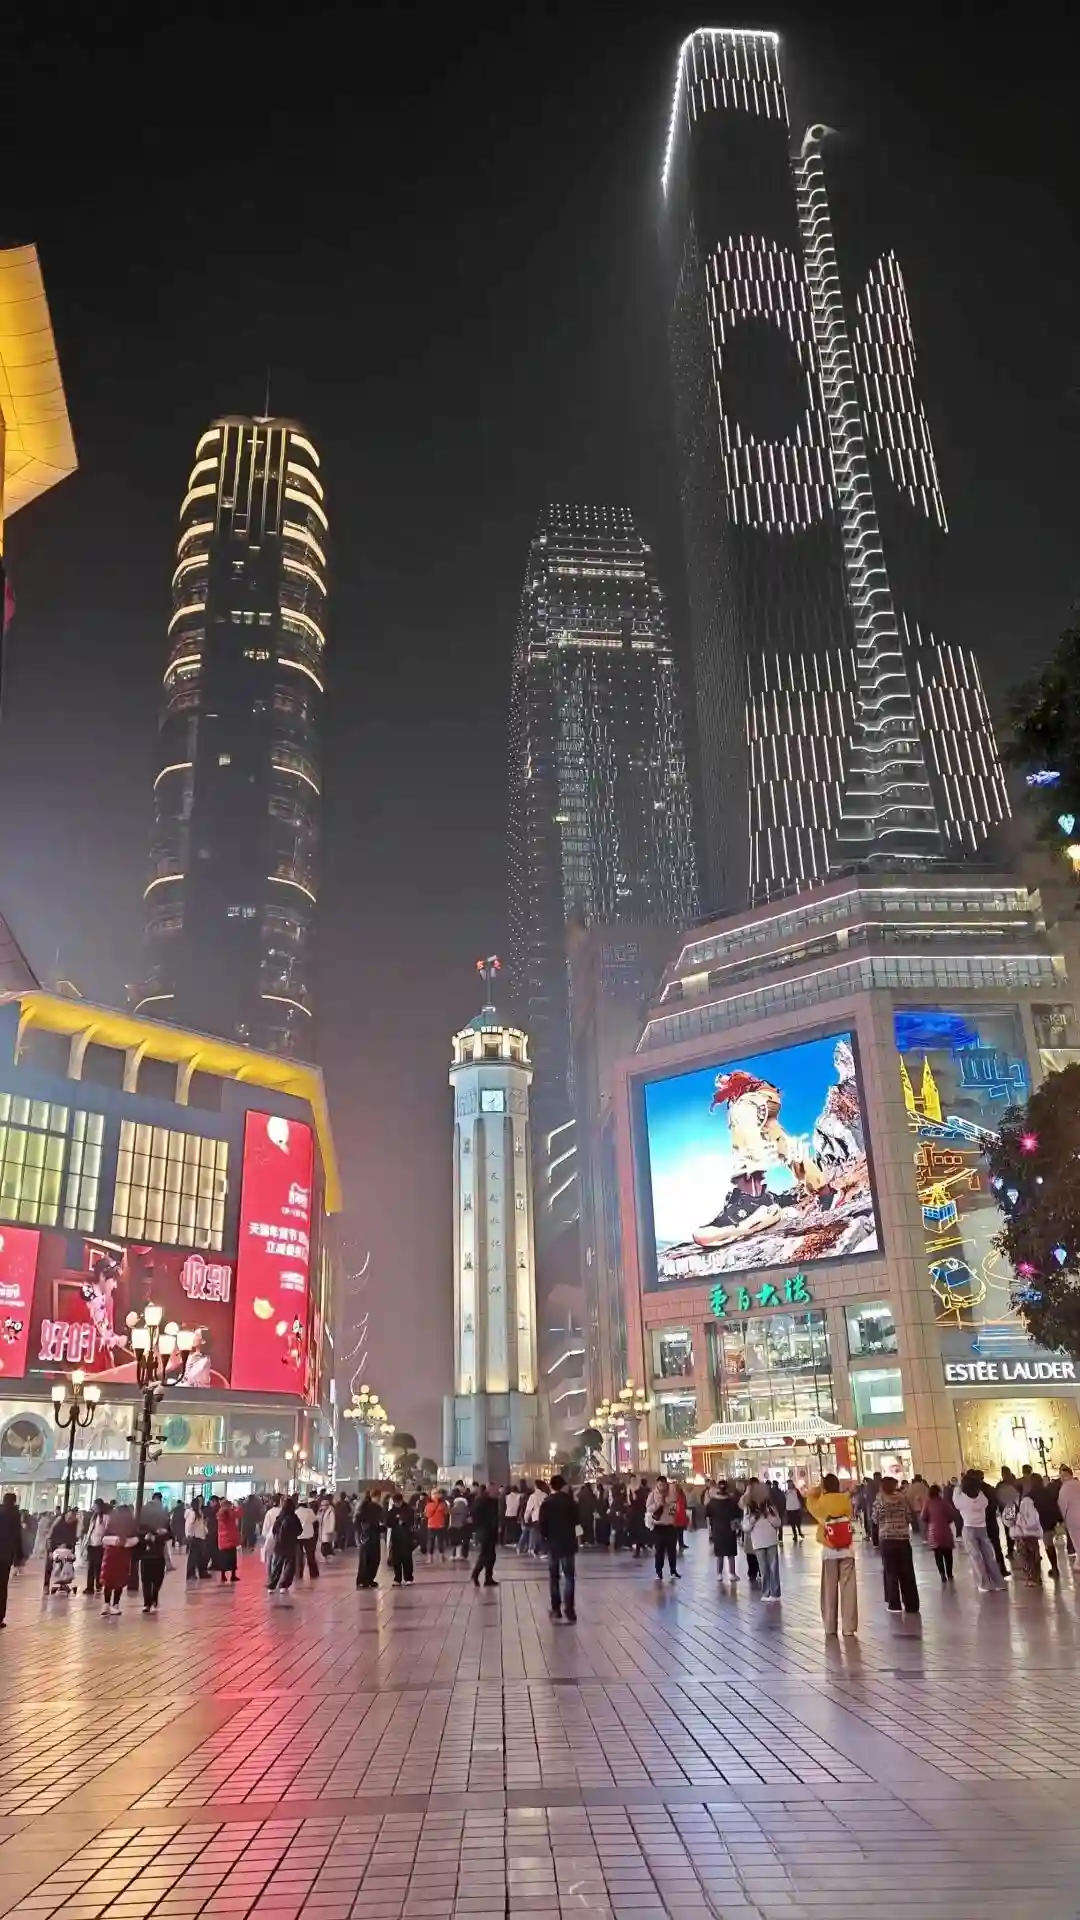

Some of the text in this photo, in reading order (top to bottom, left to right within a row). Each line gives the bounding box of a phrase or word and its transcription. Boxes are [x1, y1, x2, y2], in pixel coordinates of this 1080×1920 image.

[182, 1261, 232, 1302] 收到
[38, 1319, 96, 1363] 好的
[1002, 1361, 1076, 1380] LAUDER
